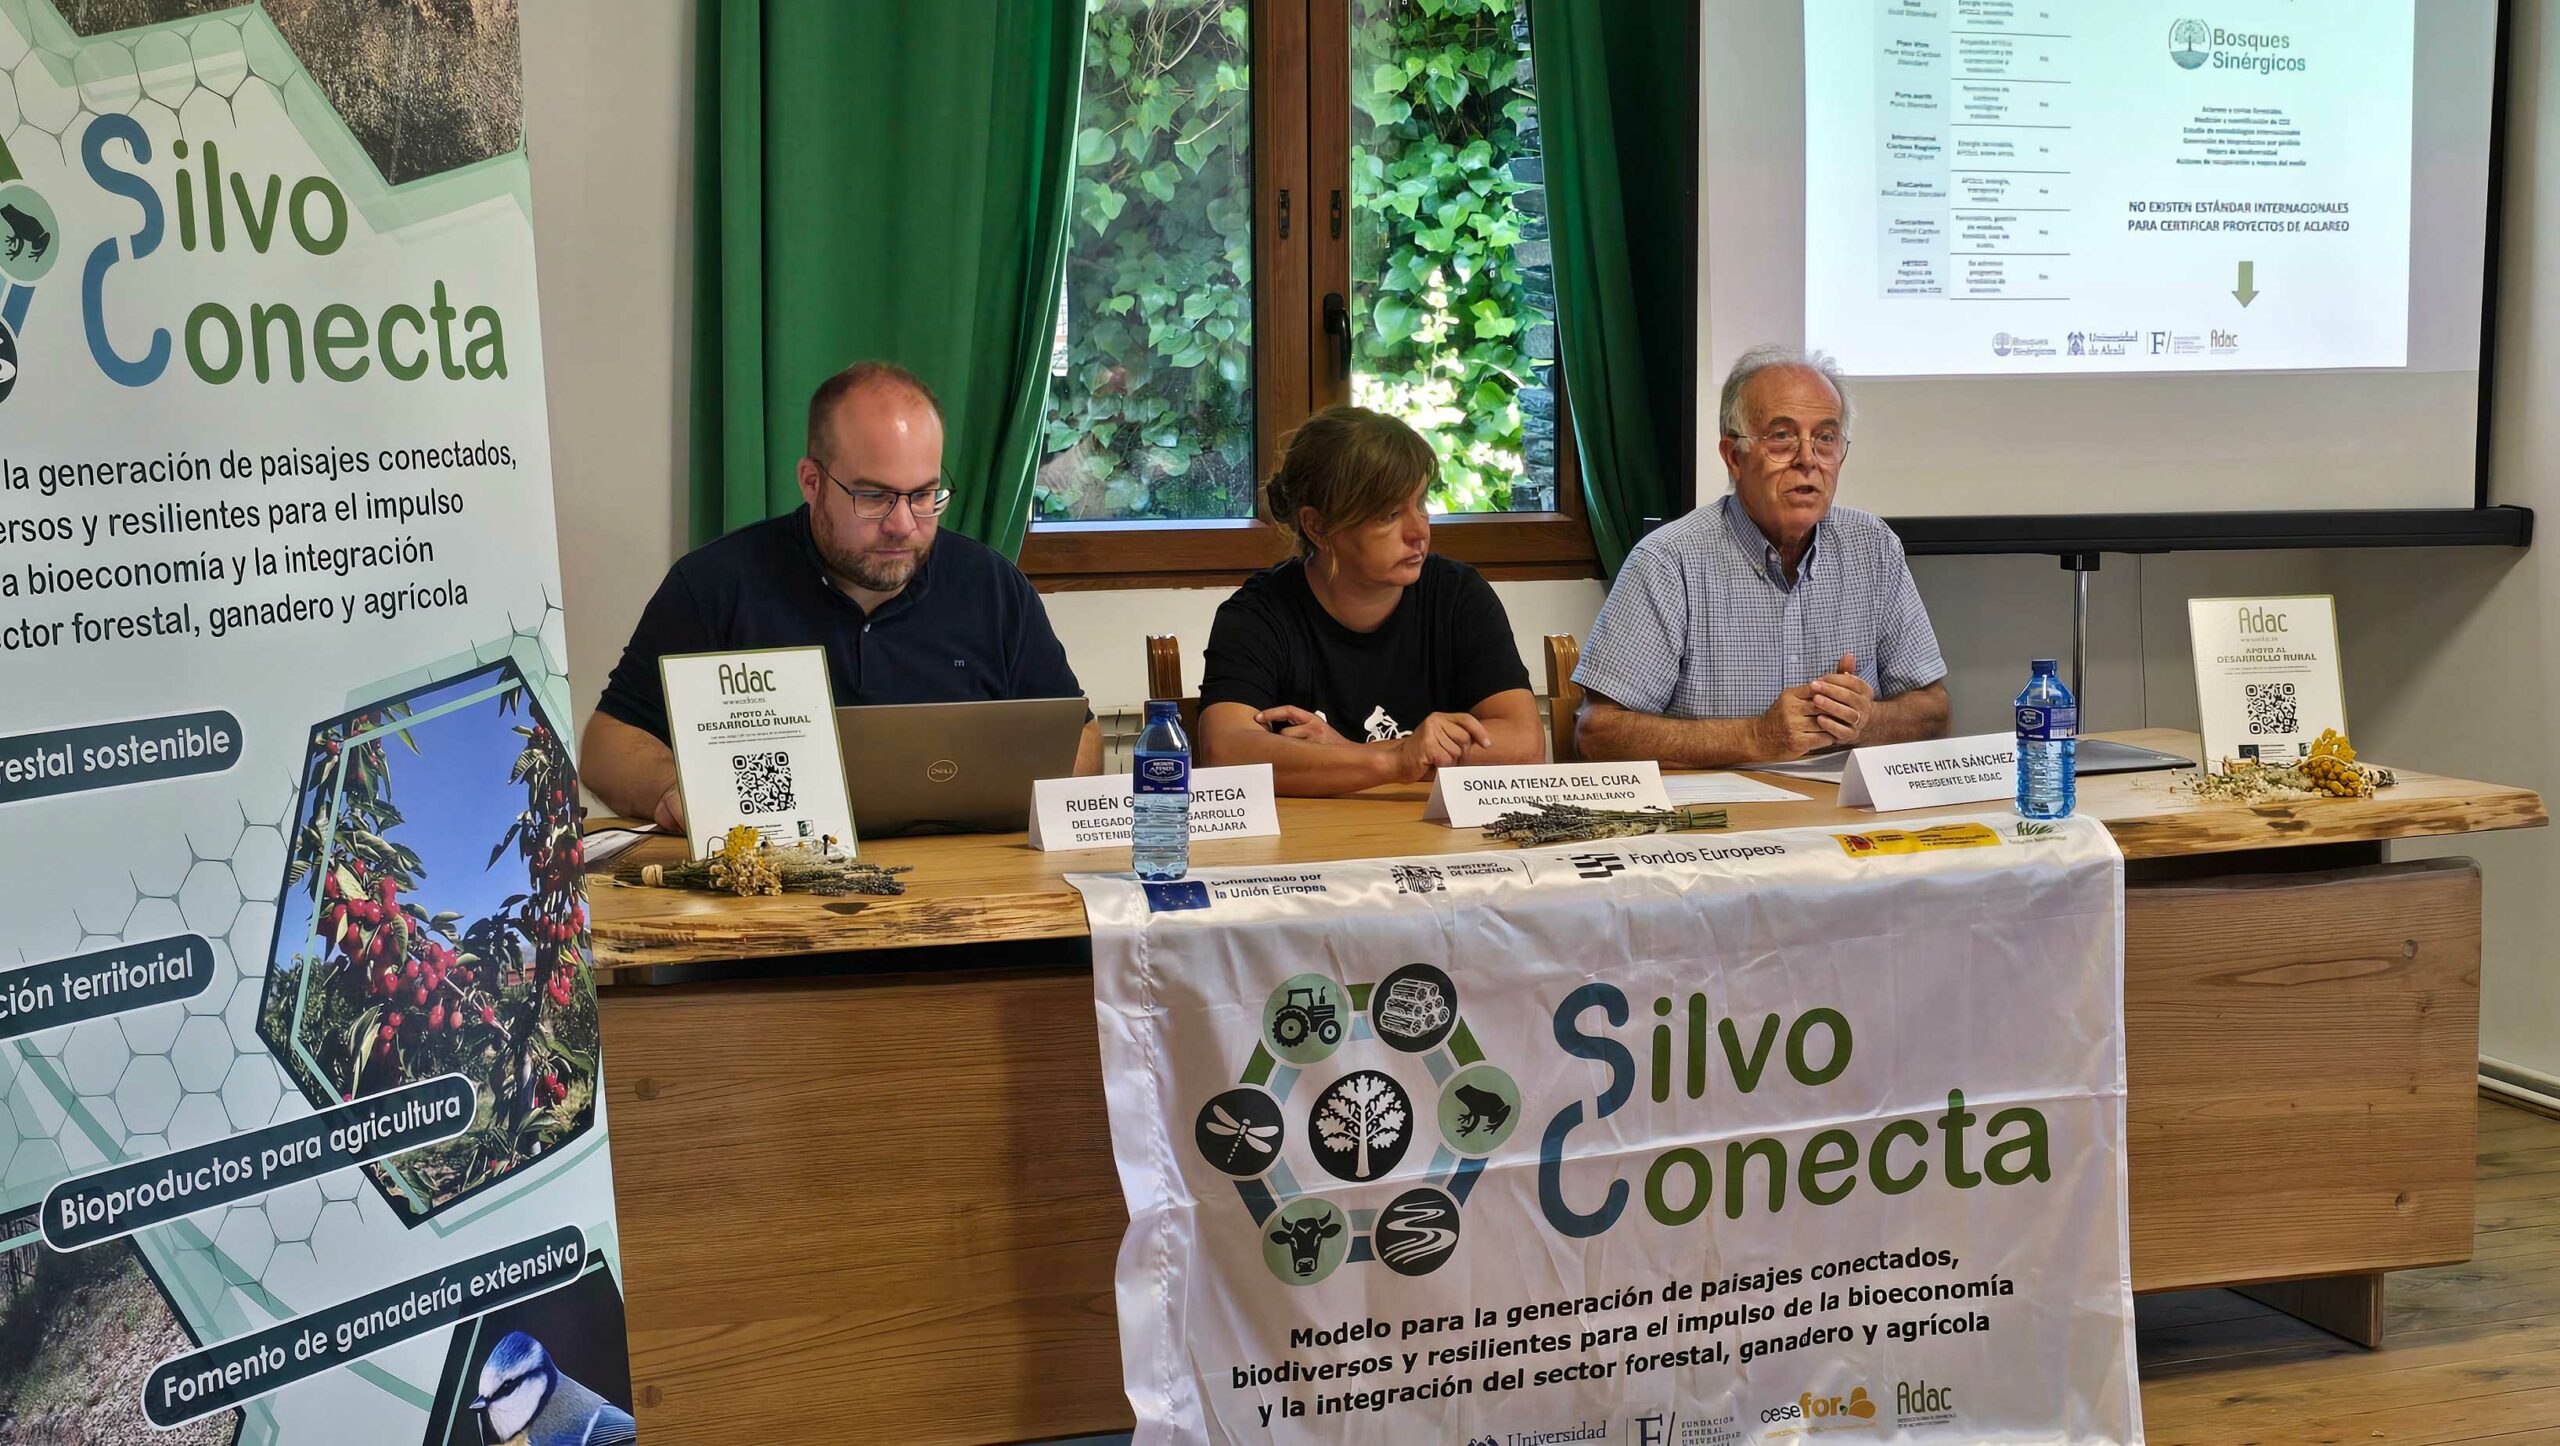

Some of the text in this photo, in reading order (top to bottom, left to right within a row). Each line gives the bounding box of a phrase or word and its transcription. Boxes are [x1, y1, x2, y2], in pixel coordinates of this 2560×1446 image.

[2213, 28, 2290, 51] Bosques
[2213, 51, 2306, 75] Sinérgicos
[81, 113, 348, 259] Silvo
[2129, 199, 2349, 214] NO EXISTEN ESTÁNDAR INTERNACIONALES
[2128, 220, 2350, 232] PARA CERTIFICAR PROYECTOS DE ACLAREO
[82, 235, 507, 387] Conecta
[2211, 329, 2237, 348] Adac
[3, 439, 517, 495] la generación de paisajes conectados,
[82, 514, 98, 546] y
[108, 496, 260, 539] resilientes
[268, 501, 327, 533] para
[335, 494, 357, 521] el
[366, 488, 464, 524] impulso
[27, 551, 224, 597] bioeconomía
[232, 557, 247, 585] y
[255, 548, 277, 576] la
[284, 537, 434, 577] integración
[0, 581, 468, 650] ctor forestal, ganadero y agrícola
[2238, 606, 2288, 634] Adac
[2217, 653, 2317, 663] DESARROLLO RURAL
[718, 662, 777, 695] Adac
[697, 715, 811, 732] DESARROLLO RURAL
[730, 709, 777, 719] APOYO AL
[83, 728, 230, 770] sostenible
[1884, 753, 2015, 776] VICENTE HITA SÁNCHEZ
[1463, 774, 1641, 791] SONIA ATIENZA DEL CURA
[1909, 772, 2002, 789] PRESIDENTE DE ADAC
[1066, 795, 1119, 812] RUBÉN
[1478, 791, 1636, 806] ALCALDESA DE MAJAELRAYO
[1072, 808, 1245, 830] DELEGADO ARROLLO
[1076, 821, 1247, 842] SOSTENIB DALAJARA
[1629, 842, 1786, 867] Fondos Europeos
[1299, 873, 1321, 882] por
[1465, 867, 1513, 875] HACIENDA
[1215, 881, 1326, 899] la Unión Europea
[62, 948, 194, 997] territorial
[1553, 982, 1853, 1120] Silvo
[62, 1093, 462, 1229] Bioproductos para agricultura
[1538, 1088, 2051, 1238] Conecta
[1291, 1246, 1960, 1348] Modelo para la generación de paisajes conectados,
[165, 1240, 579, 1408] Fomento de ganadería extensiva
[1233, 1274, 2015, 1389] biodiversos y resilientes para el impulso de la bioeconomía
[1257, 1311, 1990, 1427] y la integración del sector forestal, ganadero y agrícola
[1761, 1391, 1842, 1423] cesefor
[1897, 1380, 1952, 1415] Adac
[1507, 1420, 1607, 1446] Universidad
[1681, 1416, 1735, 1428] FUNDACIÓN
[1682, 1428, 1722, 1437] GENERAL
